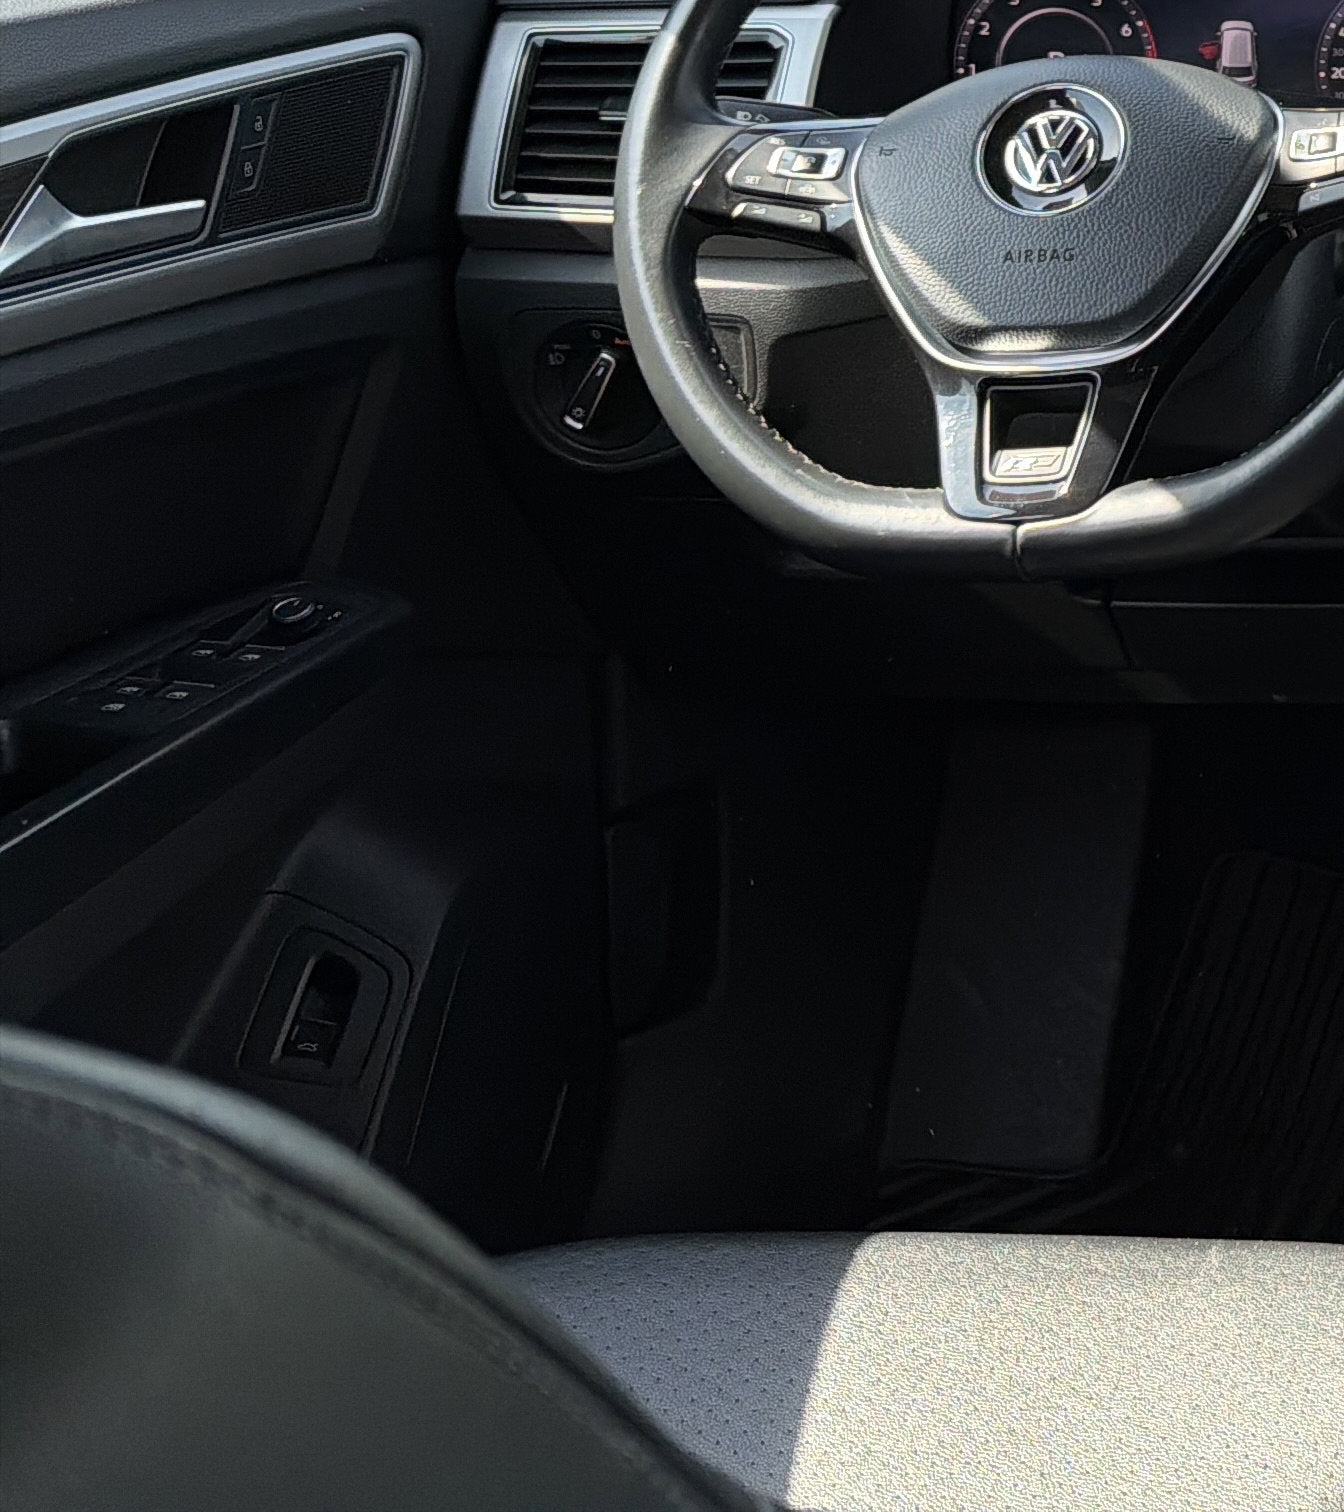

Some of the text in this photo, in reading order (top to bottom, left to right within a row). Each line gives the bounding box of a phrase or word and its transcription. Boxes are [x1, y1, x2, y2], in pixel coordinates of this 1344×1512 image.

[979, 21, 990, 36] 2
[1120, 23, 1132, 37] 6
[745, 175, 761, 185] SET
[1003, 247, 1076, 264] AIRBAG
